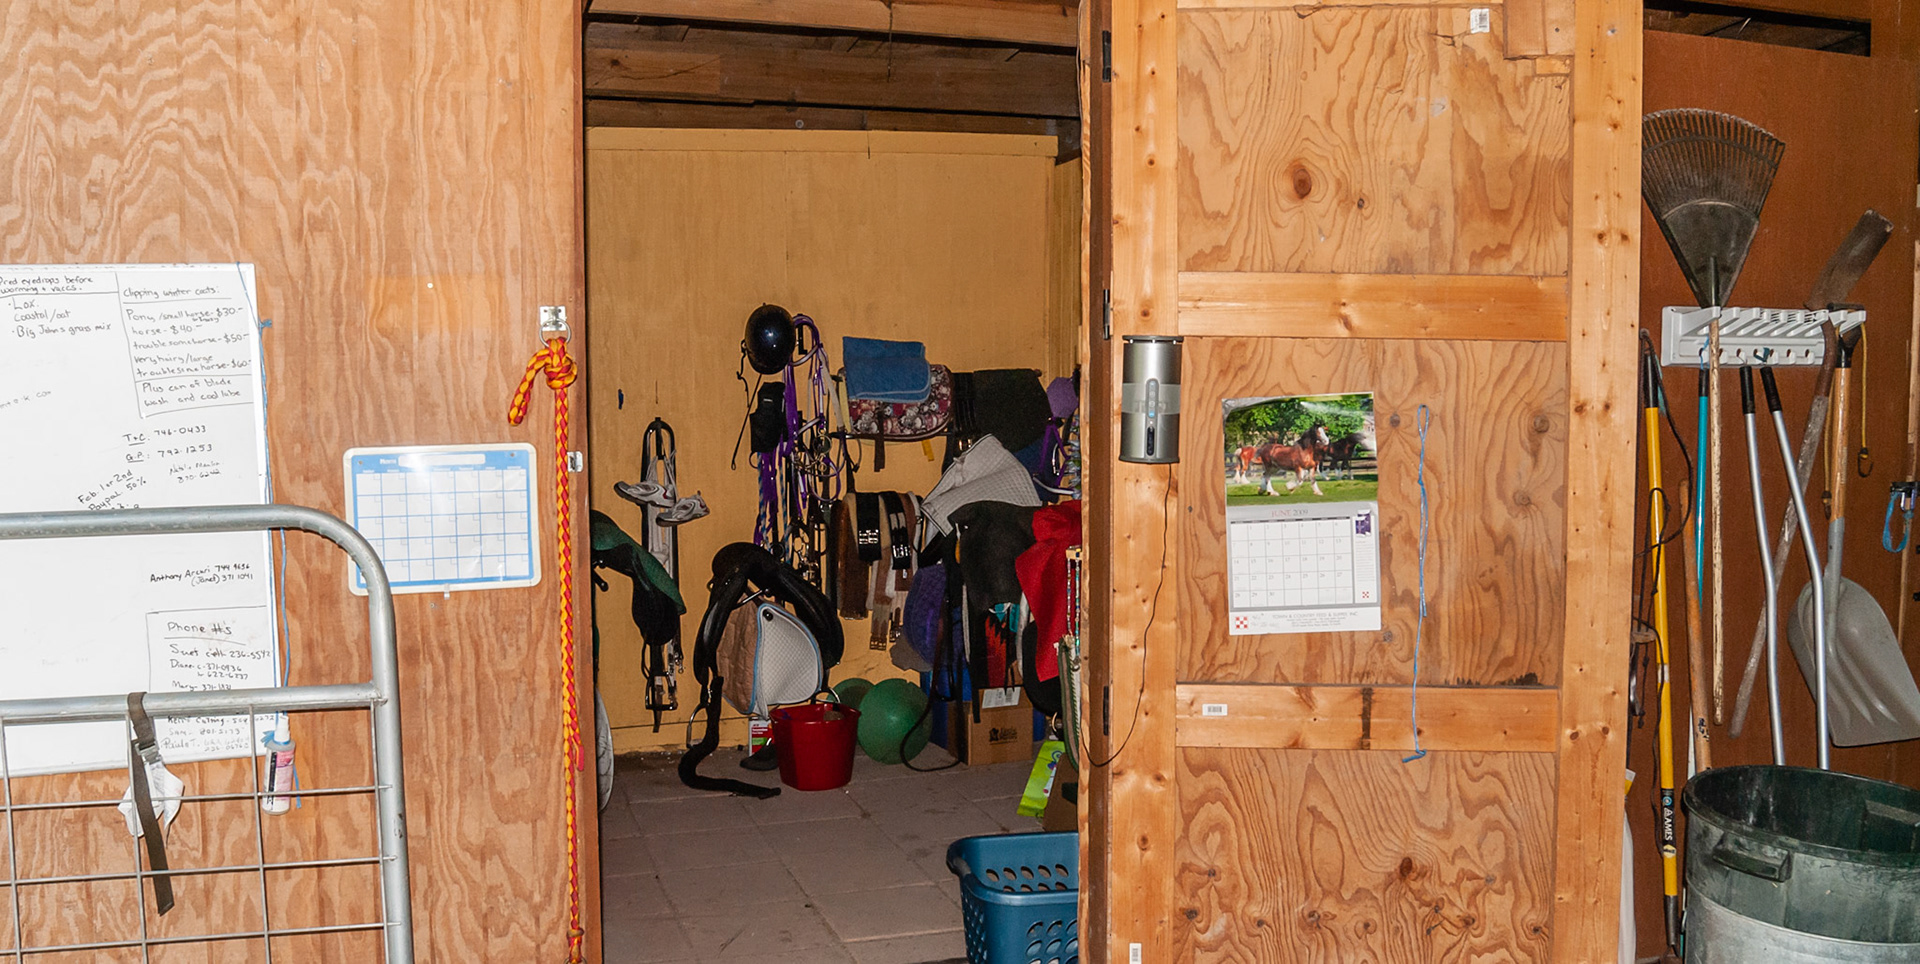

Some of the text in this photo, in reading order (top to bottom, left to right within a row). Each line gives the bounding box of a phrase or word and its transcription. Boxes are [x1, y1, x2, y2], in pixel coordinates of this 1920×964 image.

[64, 275, 94, 284] before
[142, 382, 164, 393] Plus
[149, 573, 183, 583] Anthony
[166, 621, 207, 634] Phone
[1664, 817, 1673, 841] AMES
